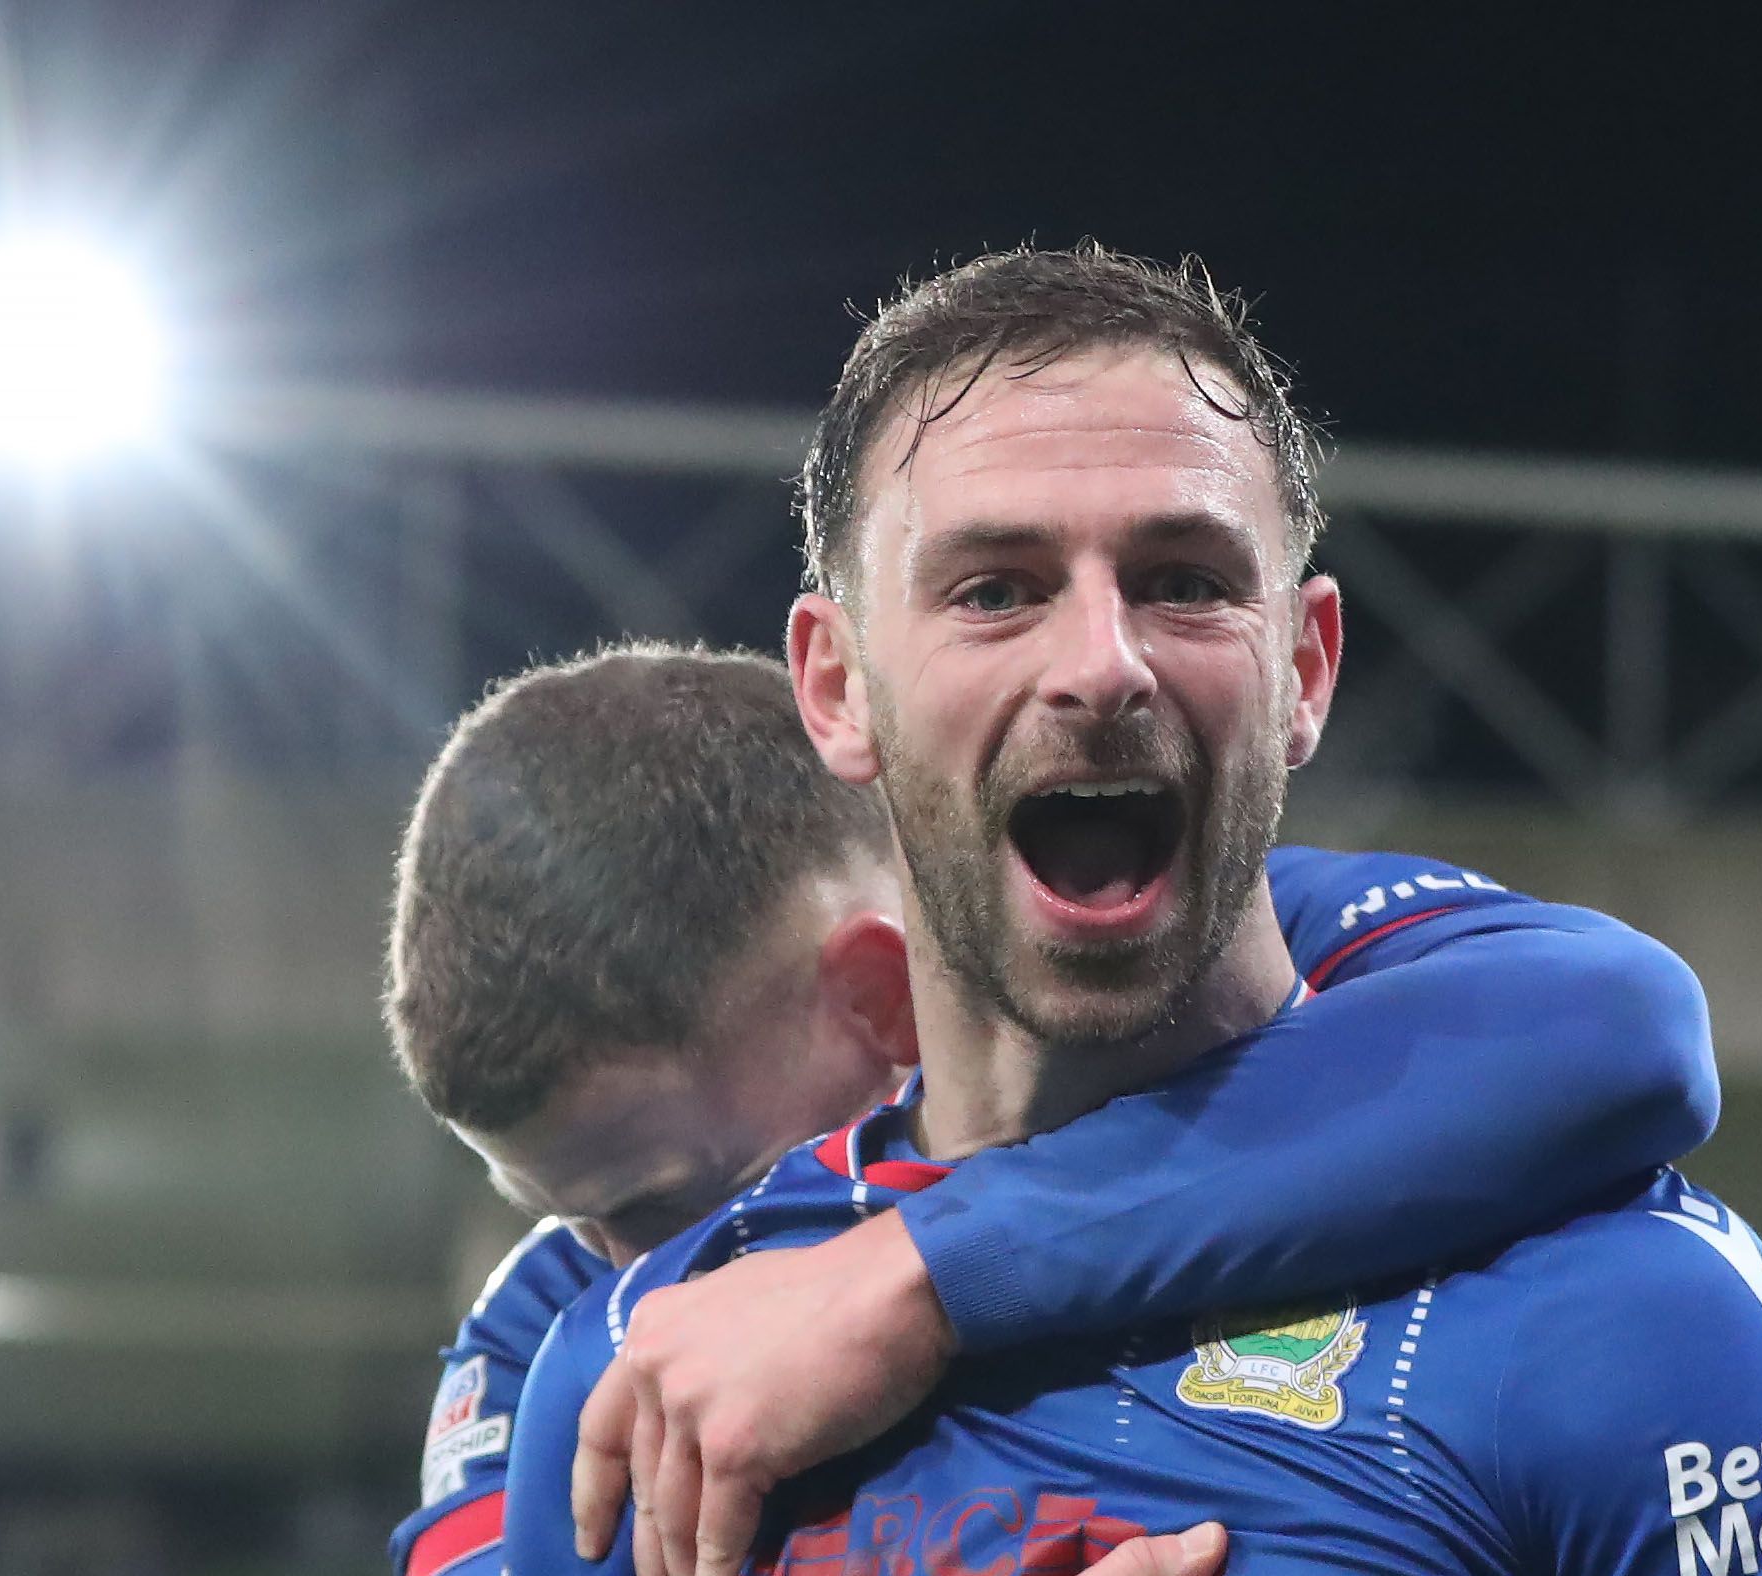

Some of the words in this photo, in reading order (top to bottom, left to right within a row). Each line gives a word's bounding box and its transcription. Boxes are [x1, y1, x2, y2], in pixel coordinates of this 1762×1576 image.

[1250, 1364, 1279, 1377] LFC
[1233, 1393, 1280, 1411] FORTUNA
[1294, 1404, 1325, 1419] JUVAT
